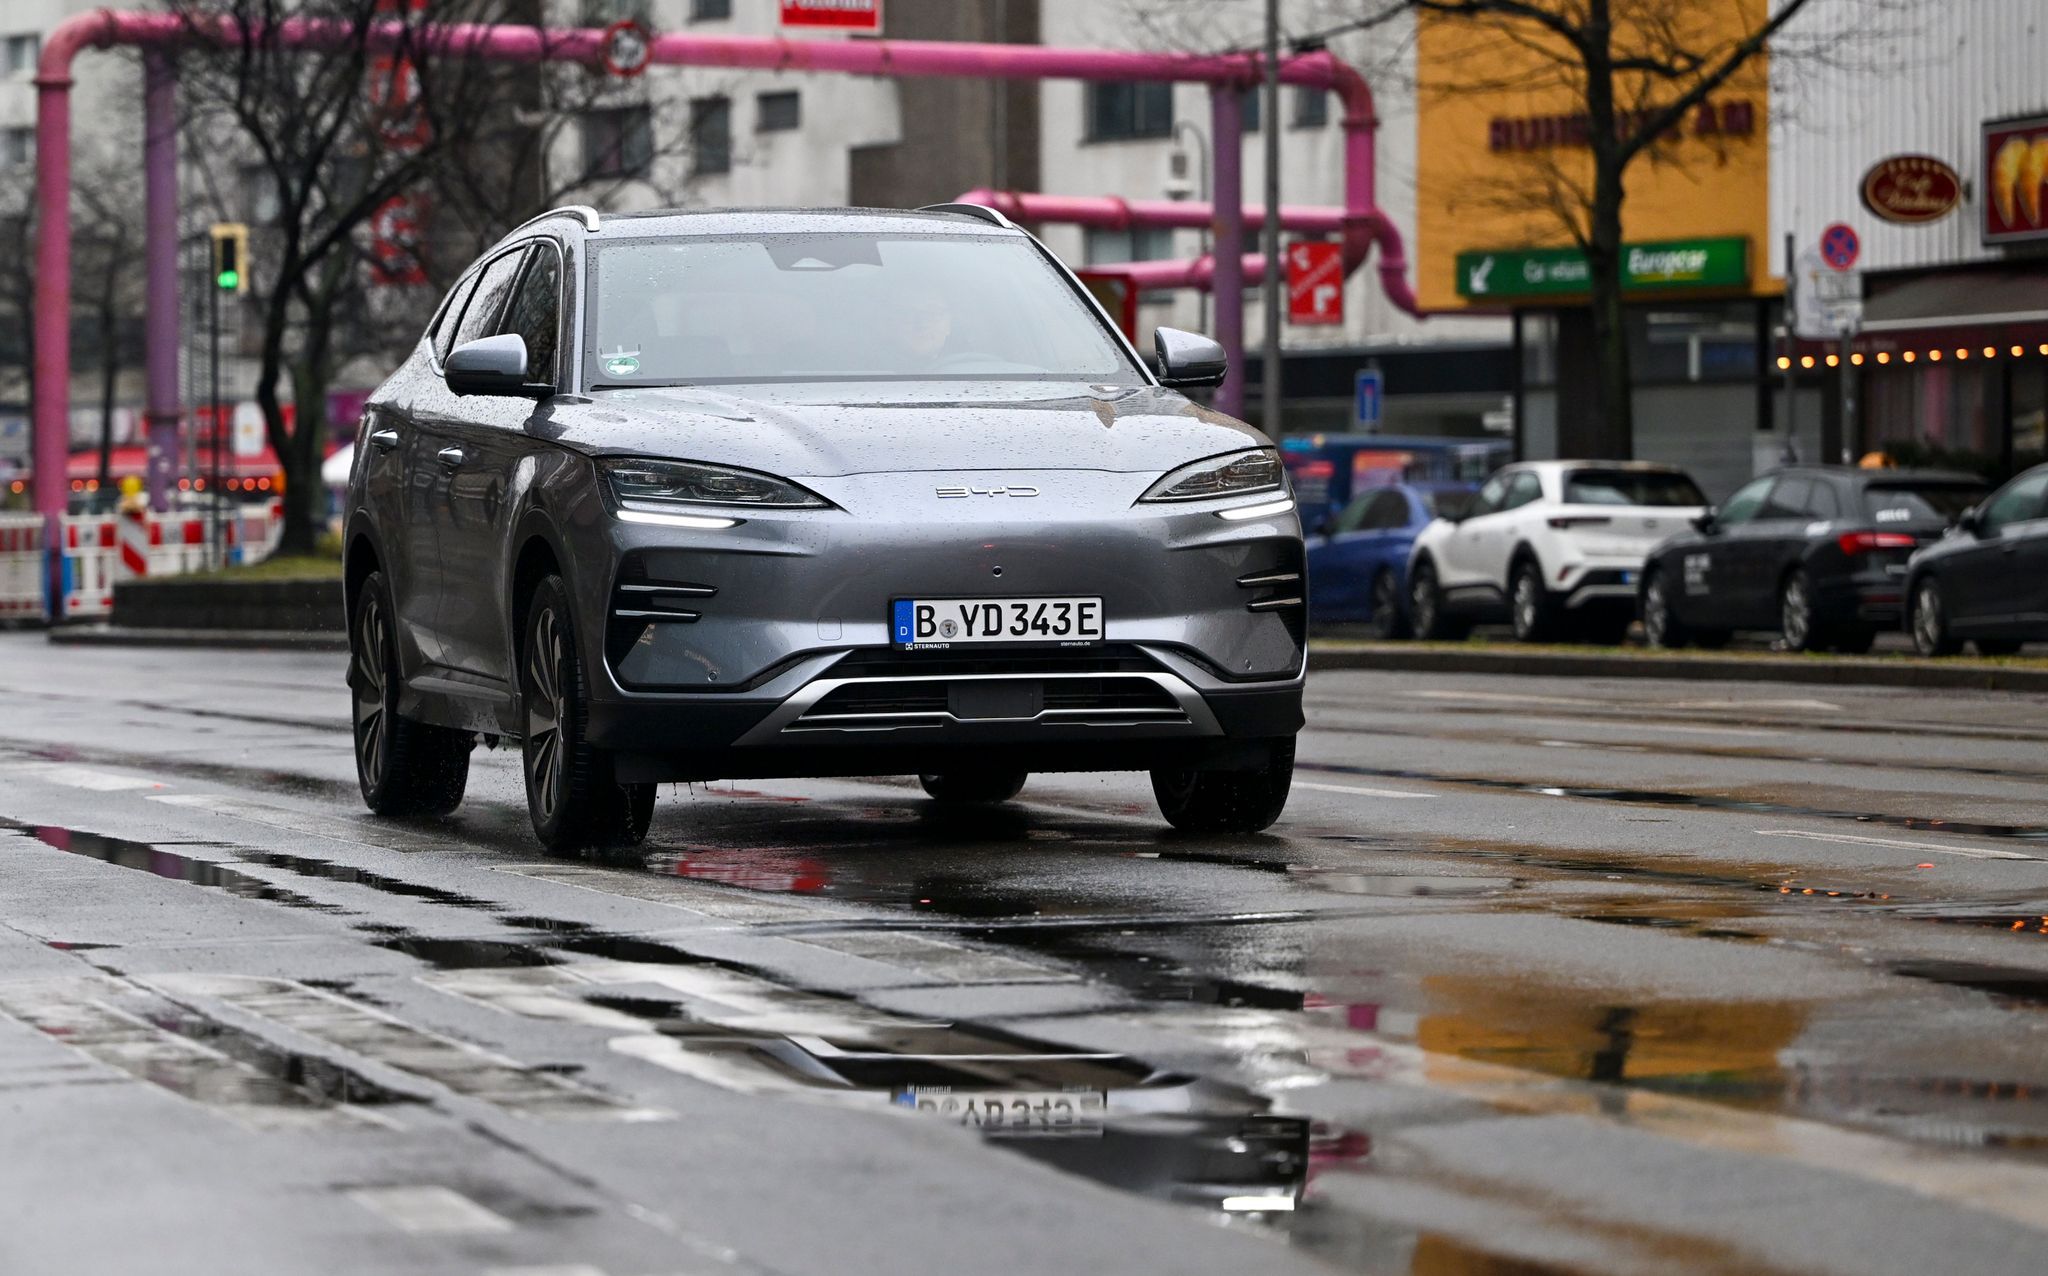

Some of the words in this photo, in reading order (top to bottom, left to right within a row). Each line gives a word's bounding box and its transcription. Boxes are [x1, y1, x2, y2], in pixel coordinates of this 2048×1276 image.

[1628, 249, 1708, 276] Europcar
[936, 486, 1040, 498] BYD
[900, 626, 908, 636] D
[916, 605, 937, 638] B
